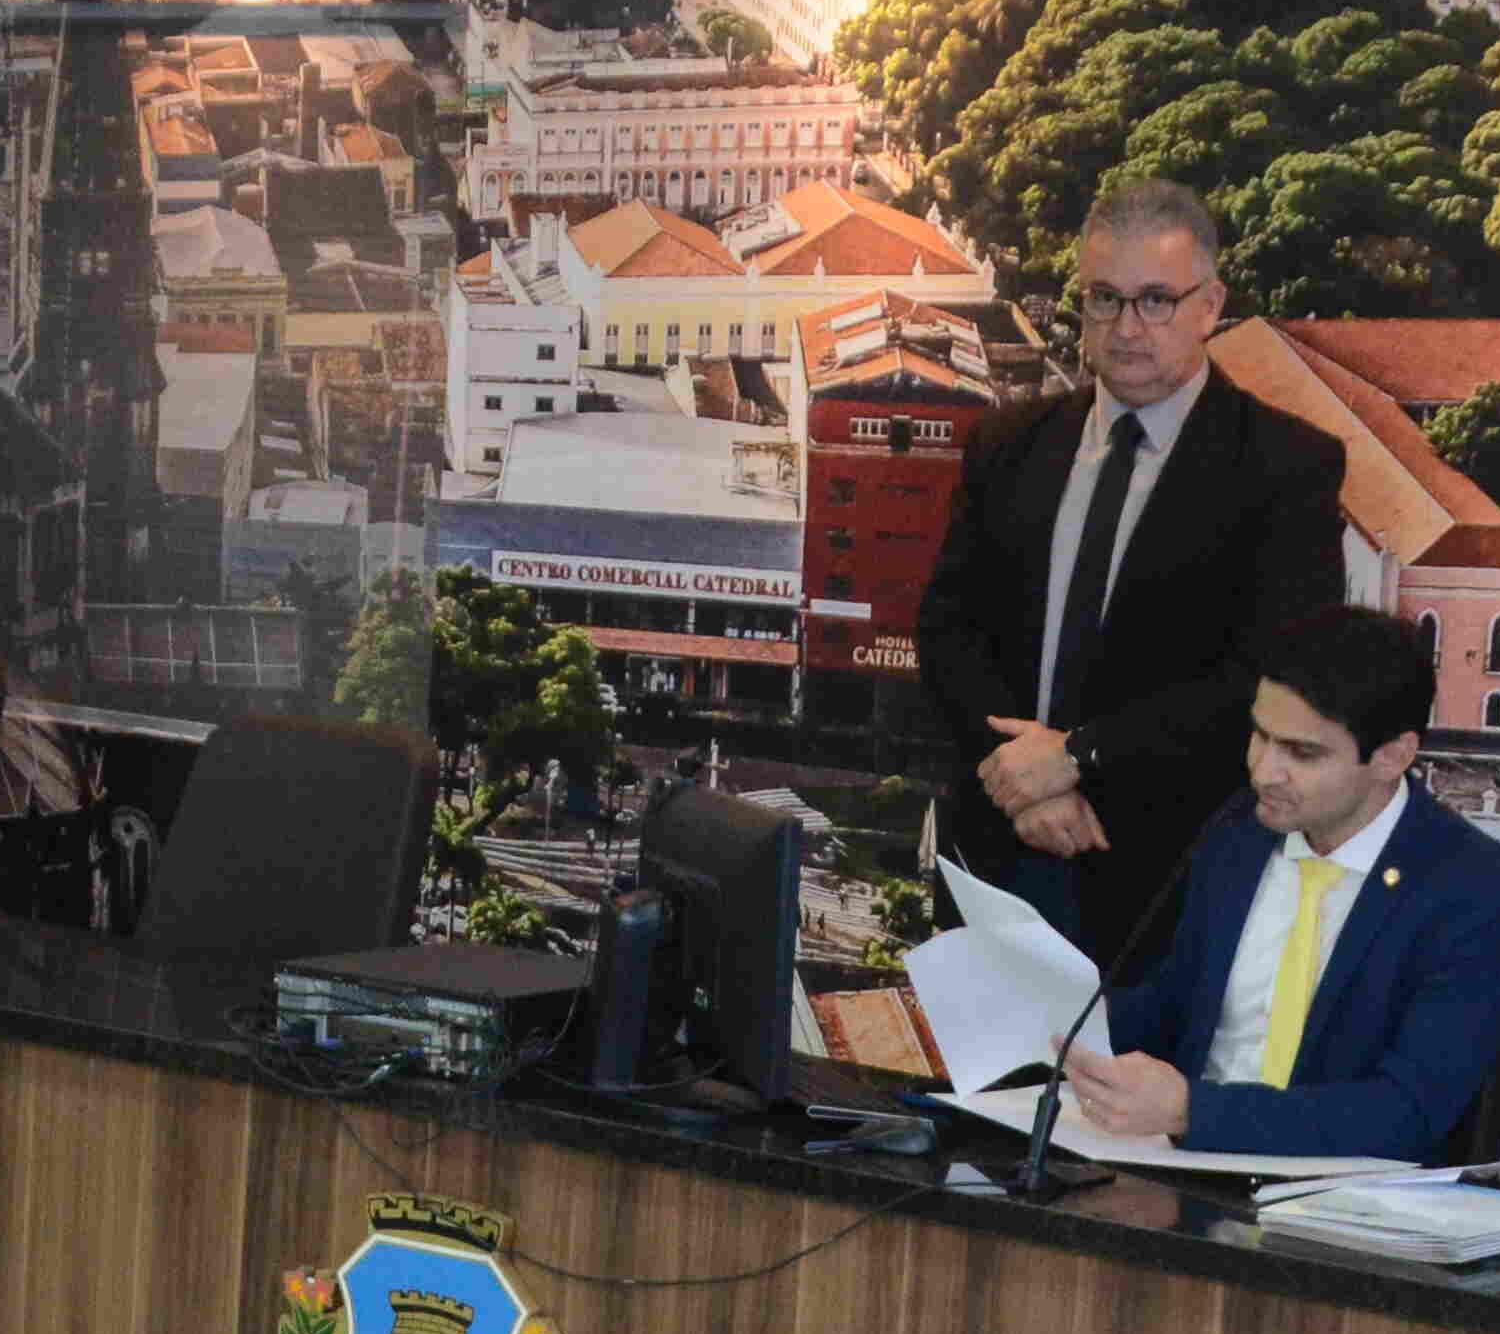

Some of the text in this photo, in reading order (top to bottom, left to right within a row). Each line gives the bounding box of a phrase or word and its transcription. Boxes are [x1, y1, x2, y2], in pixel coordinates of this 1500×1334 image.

[498, 558, 795, 598] CENTRO COMERCIAL CATEDRAL
[874, 636, 915, 648] HOTEL
[852, 646, 919, 668] CATEDR
